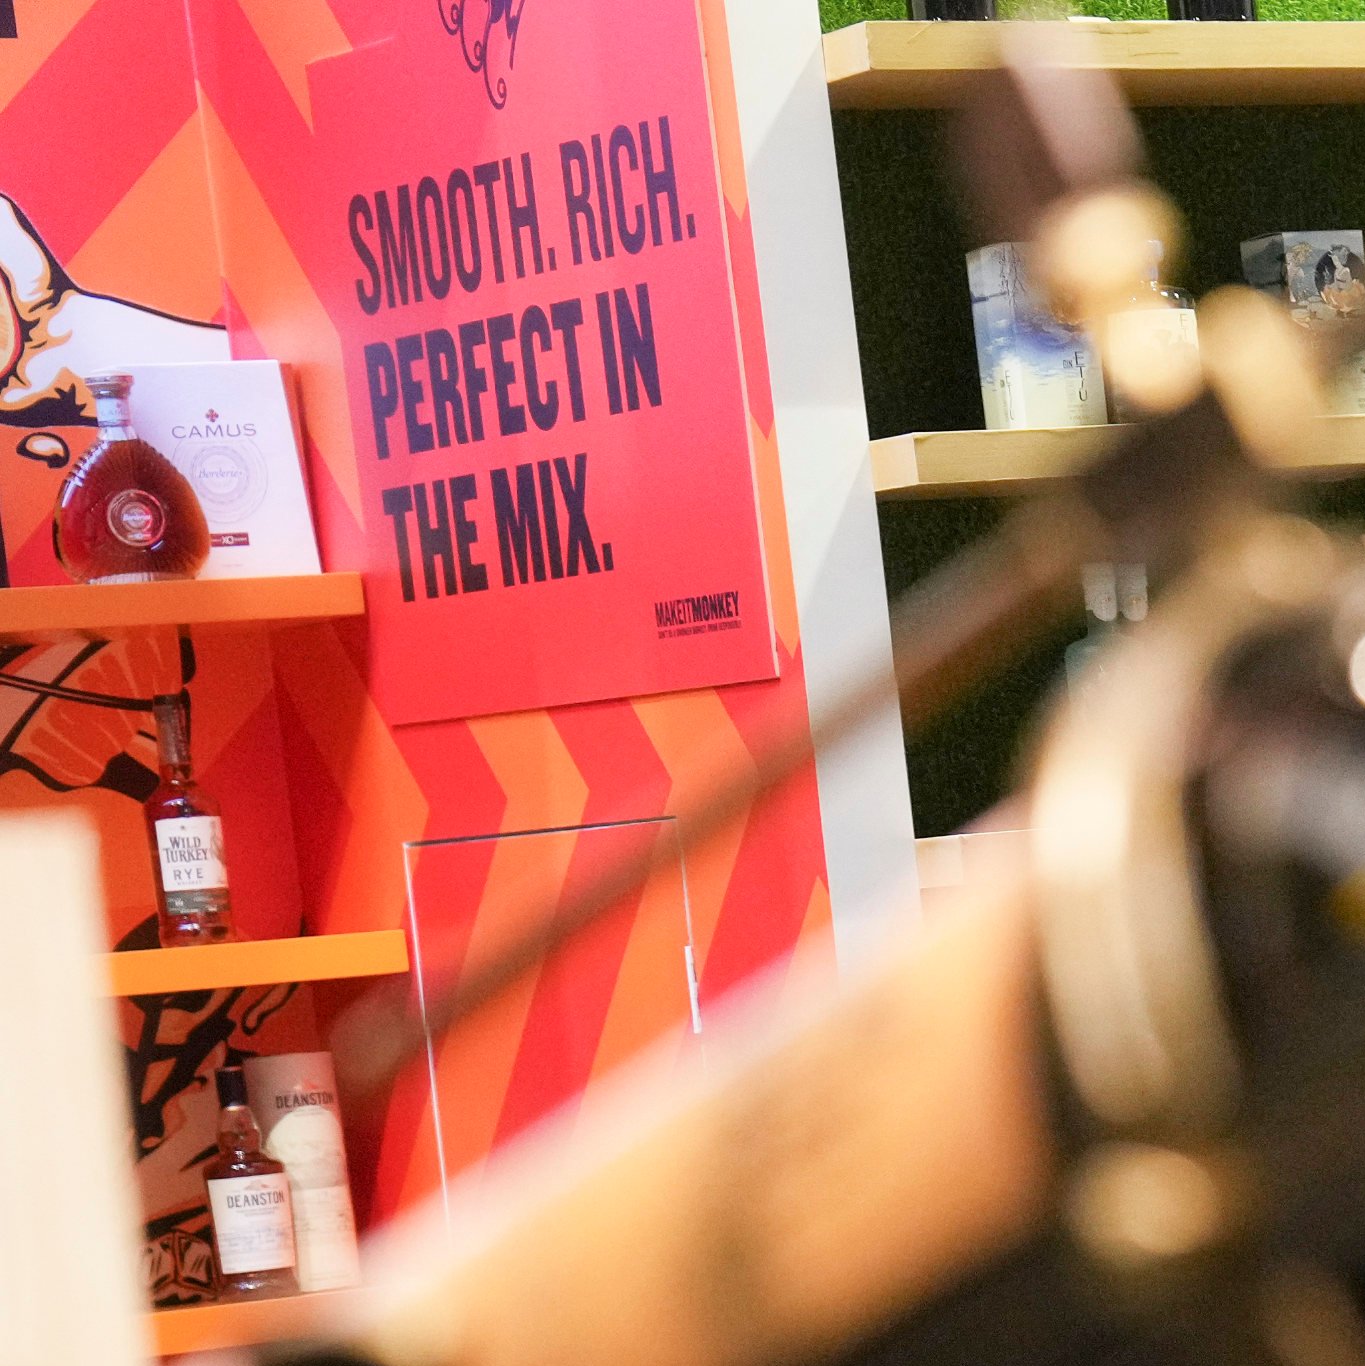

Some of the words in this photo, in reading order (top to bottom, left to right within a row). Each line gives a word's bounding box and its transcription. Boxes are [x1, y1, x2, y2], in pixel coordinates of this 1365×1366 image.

[348, 152, 557, 316] SMOOTH.
[559, 115, 697, 267] RICH.
[363, 297, 587, 461] PERFECT
[595, 282, 663, 416] IN
[171, 423, 258, 440] CAMUS
[382, 472, 489, 603] THE
[489, 452, 614, 588] MIX.
[169, 836, 201, 850] WILD
[163, 847, 208, 863] TURKEY
[173, 868, 204, 881] RYE
[276, 1091, 335, 1109] DEANSTON
[227, 1191, 285, 1209] DEANSTON
